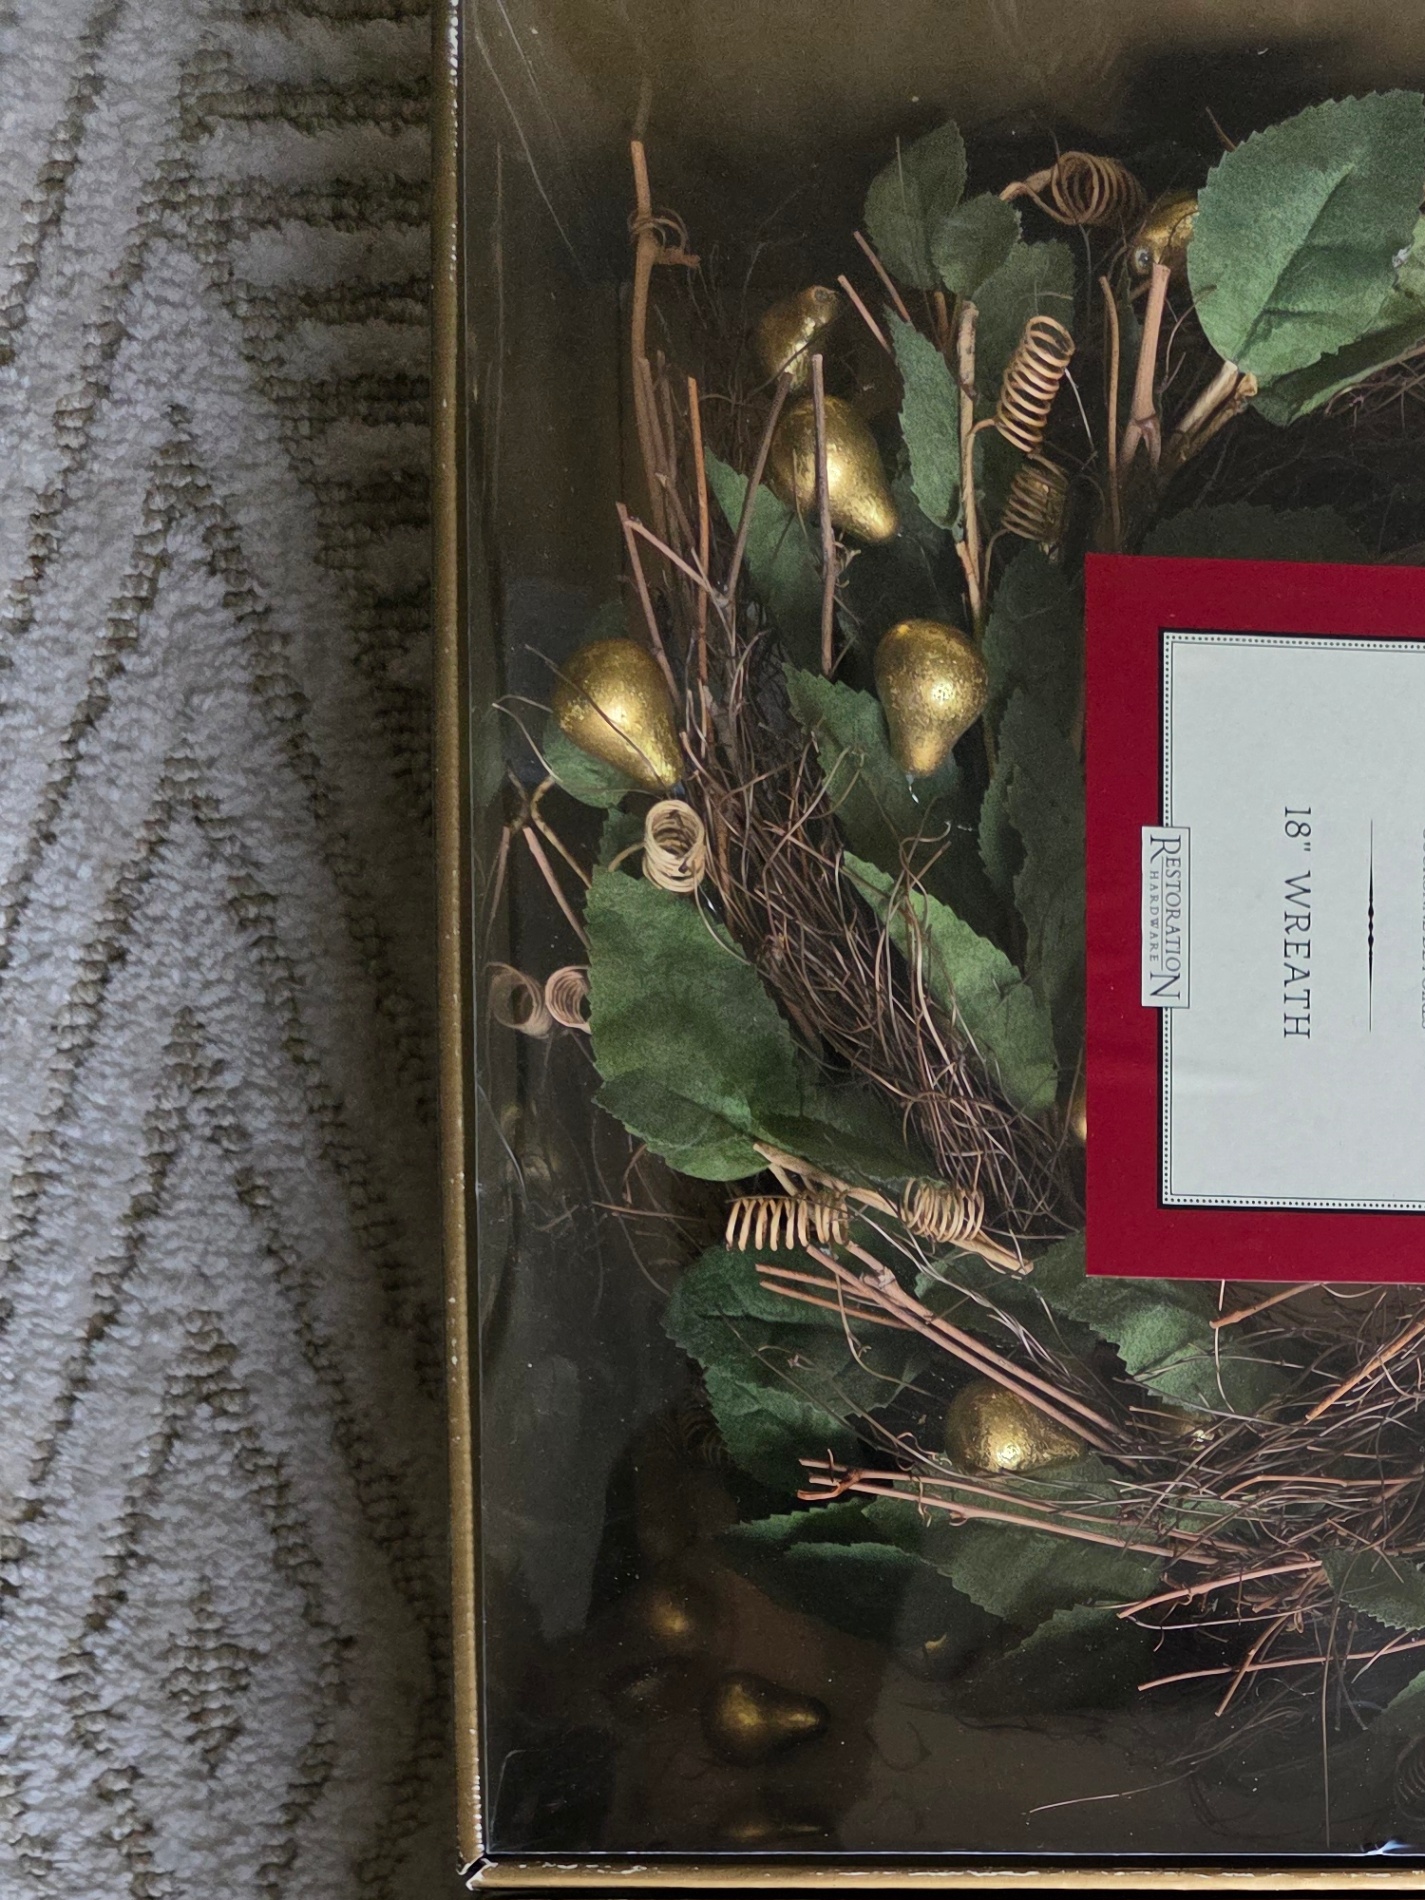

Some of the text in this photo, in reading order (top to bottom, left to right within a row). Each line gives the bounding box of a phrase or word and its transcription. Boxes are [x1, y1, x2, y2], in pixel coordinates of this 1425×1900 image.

[1150, 871, 1159, 961] HARDWARE
[1150, 834, 1181, 1000] RESTORATION
[1284, 806, 1311, 1039] 18" WREATH
